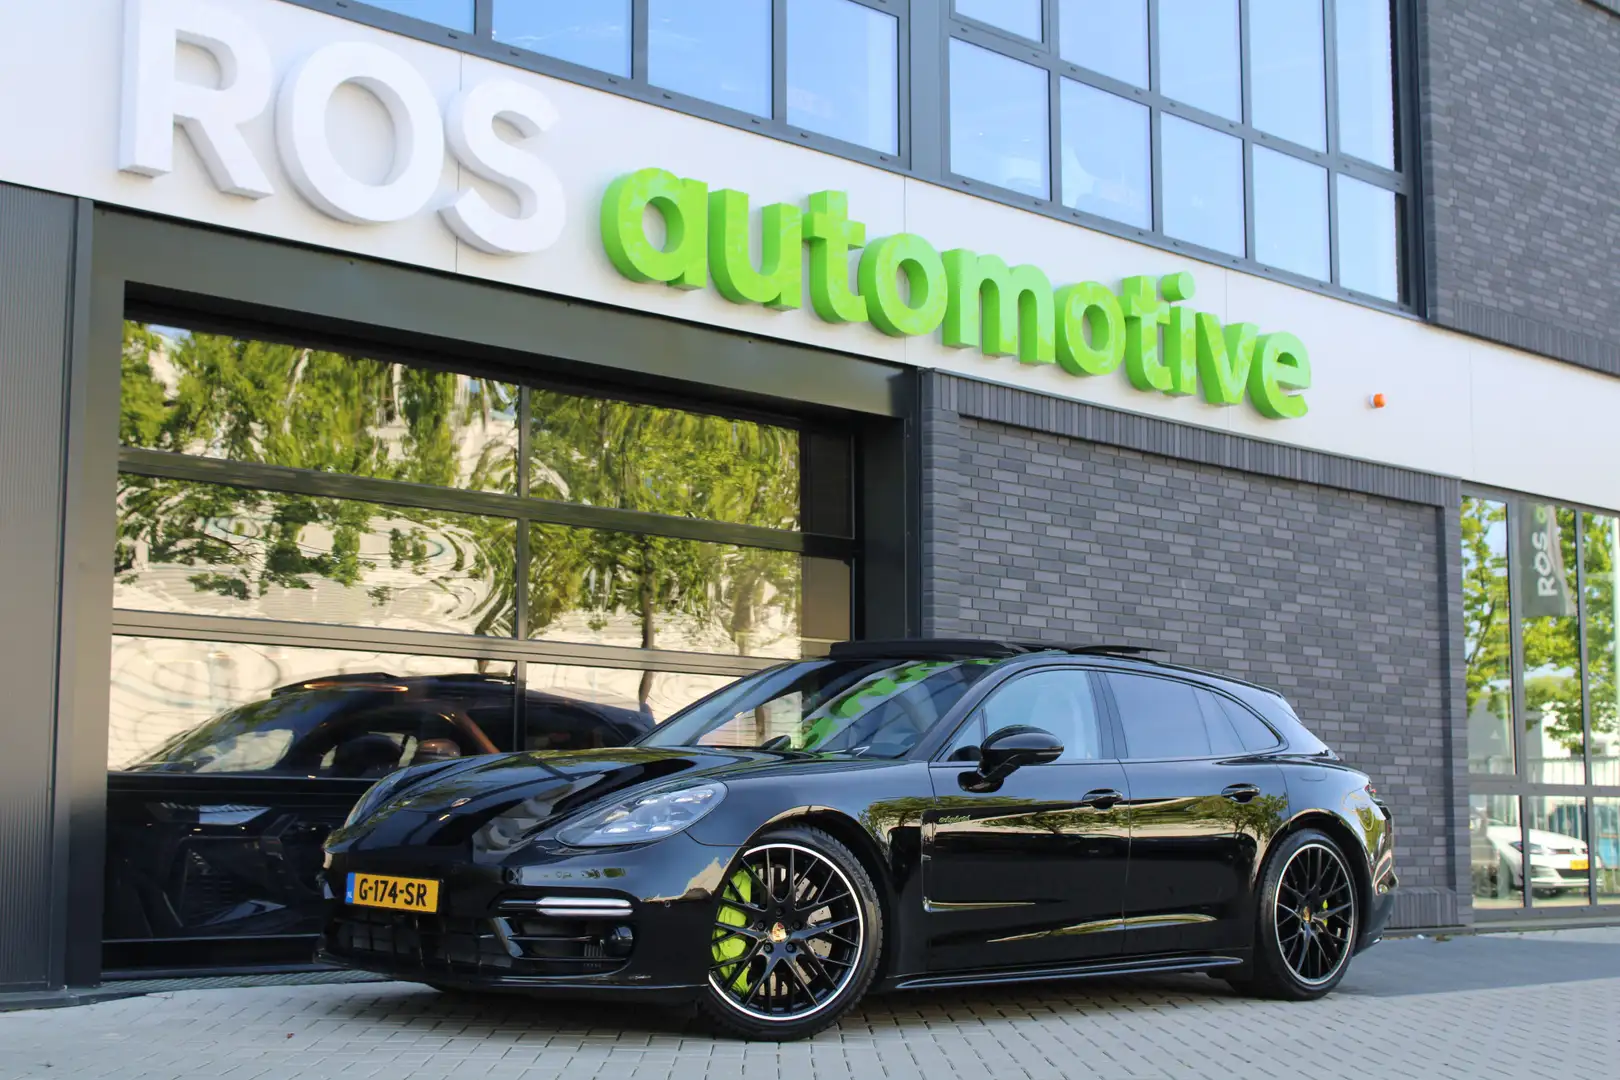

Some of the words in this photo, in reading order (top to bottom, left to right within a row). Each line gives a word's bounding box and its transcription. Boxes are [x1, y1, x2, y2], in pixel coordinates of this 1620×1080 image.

[118, 0, 567, 255] ROS
[600, 166, 1312, 420] automotive
[1532, 531, 1558, 597] ROS
[359, 878, 427, 907] G-174-SR
